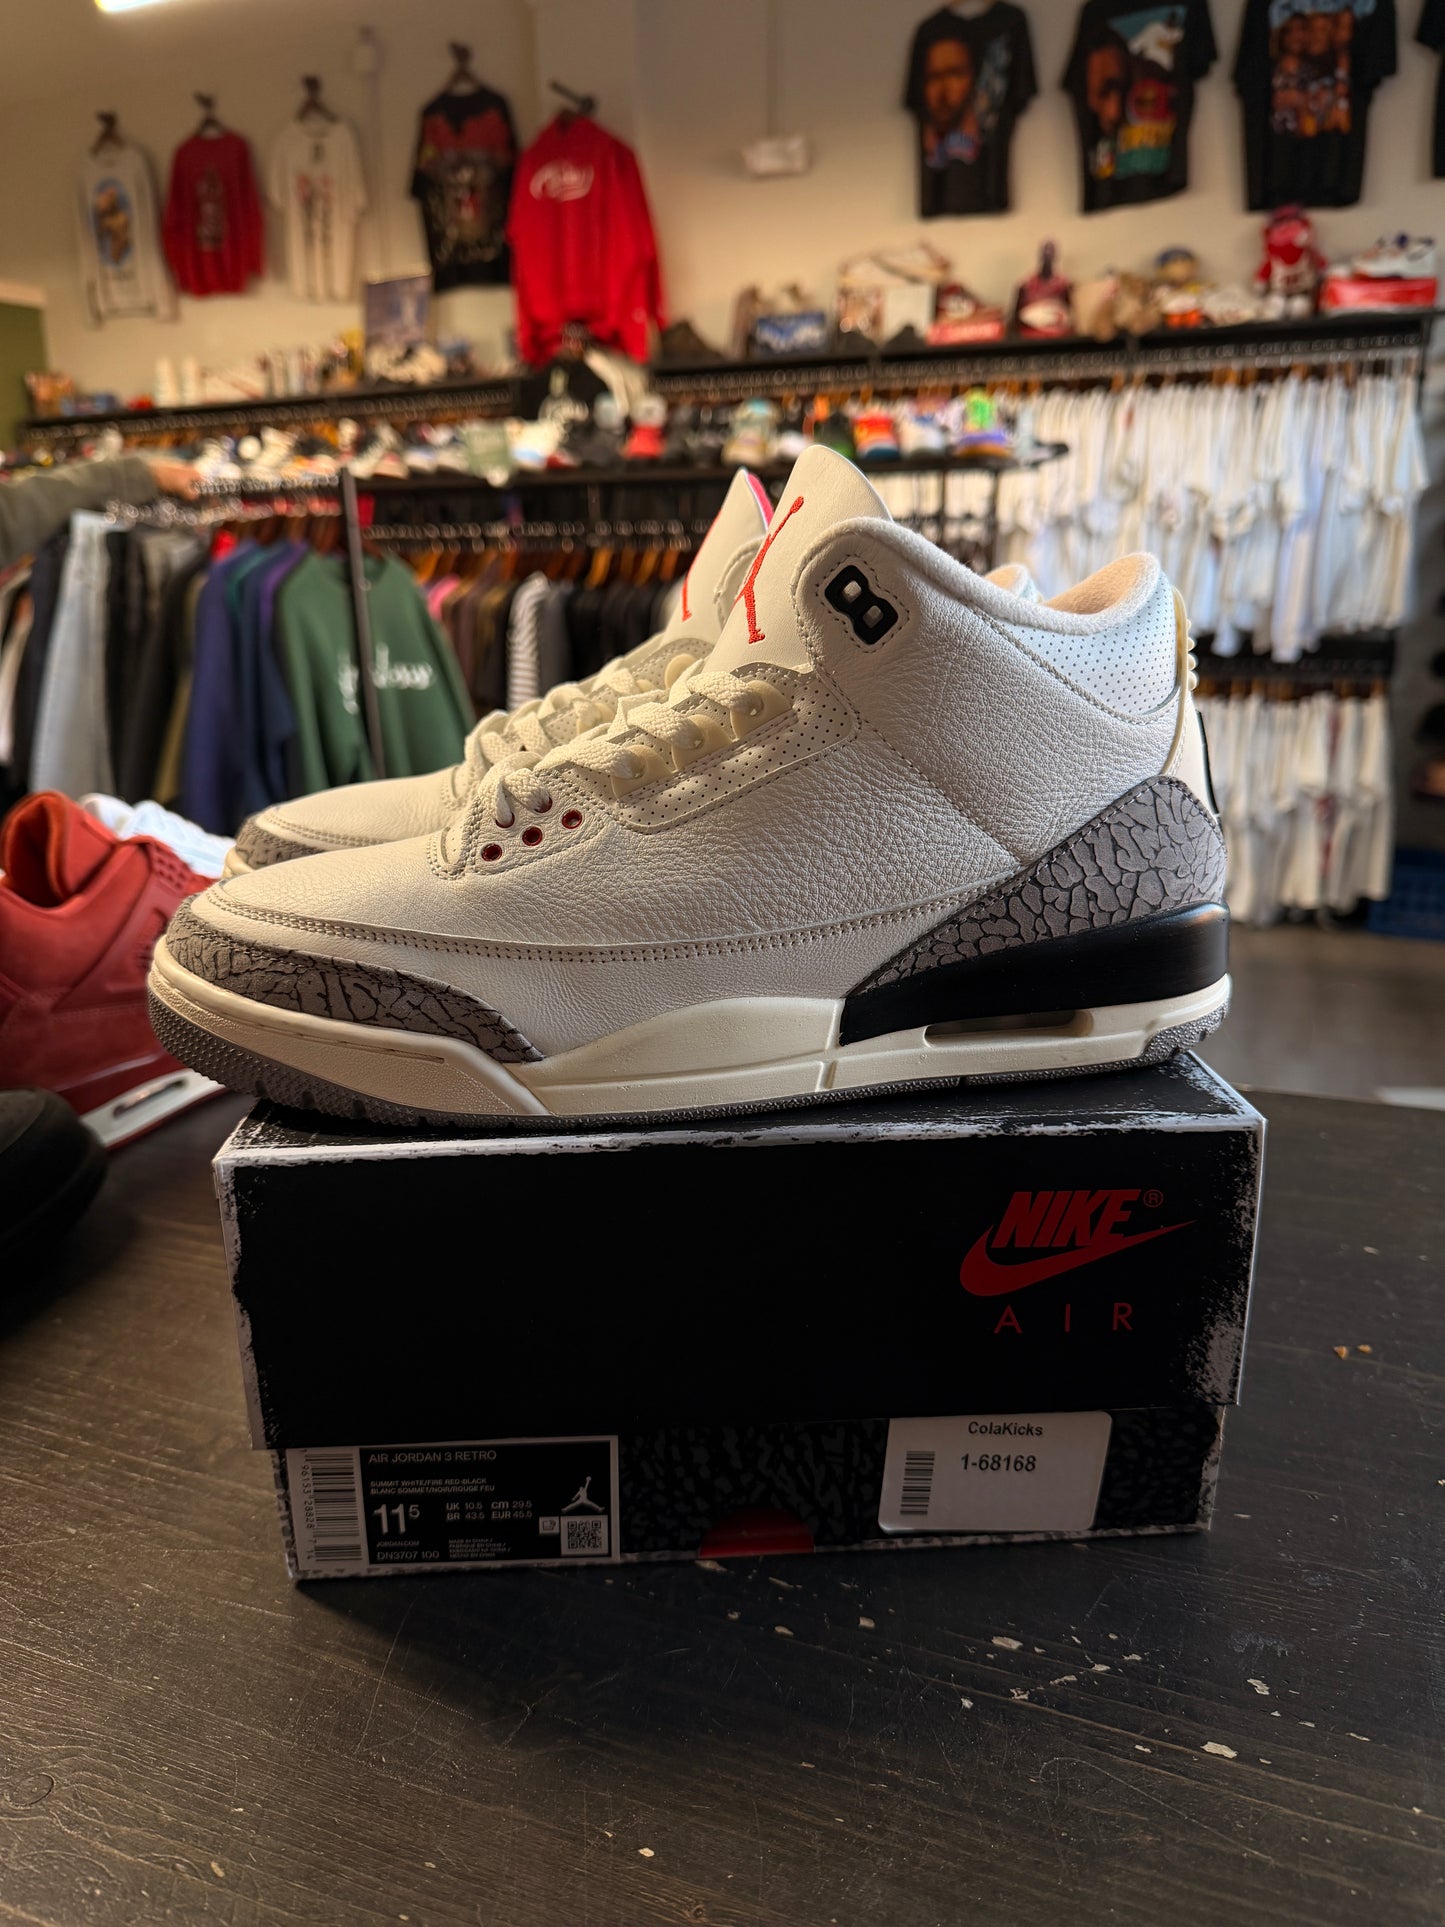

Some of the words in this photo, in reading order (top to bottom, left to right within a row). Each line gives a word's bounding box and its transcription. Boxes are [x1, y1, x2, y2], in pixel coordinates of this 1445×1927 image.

[993, 1302, 1133, 1334] AIR
[968, 1421, 1044, 1437] ColaKicks
[368, 1453, 389, 1464] AIR
[391, 1452, 441, 1463] JORDAN
[444, 1451, 452, 1462] 3
[455, 1450, 497, 1461] RETRO
[961, 1453, 1037, 1473] 1-68168
[446, 1502, 460, 1511] UK
[464, 1501, 483, 1510] 10.5
[491, 1501, 509, 1509] cm
[512, 1500, 532, 1509] 29.5
[446, 1511, 460, 1521] BR
[491, 1510, 511, 1519] EUR
[377, 1551, 418, 1561] DN3707
